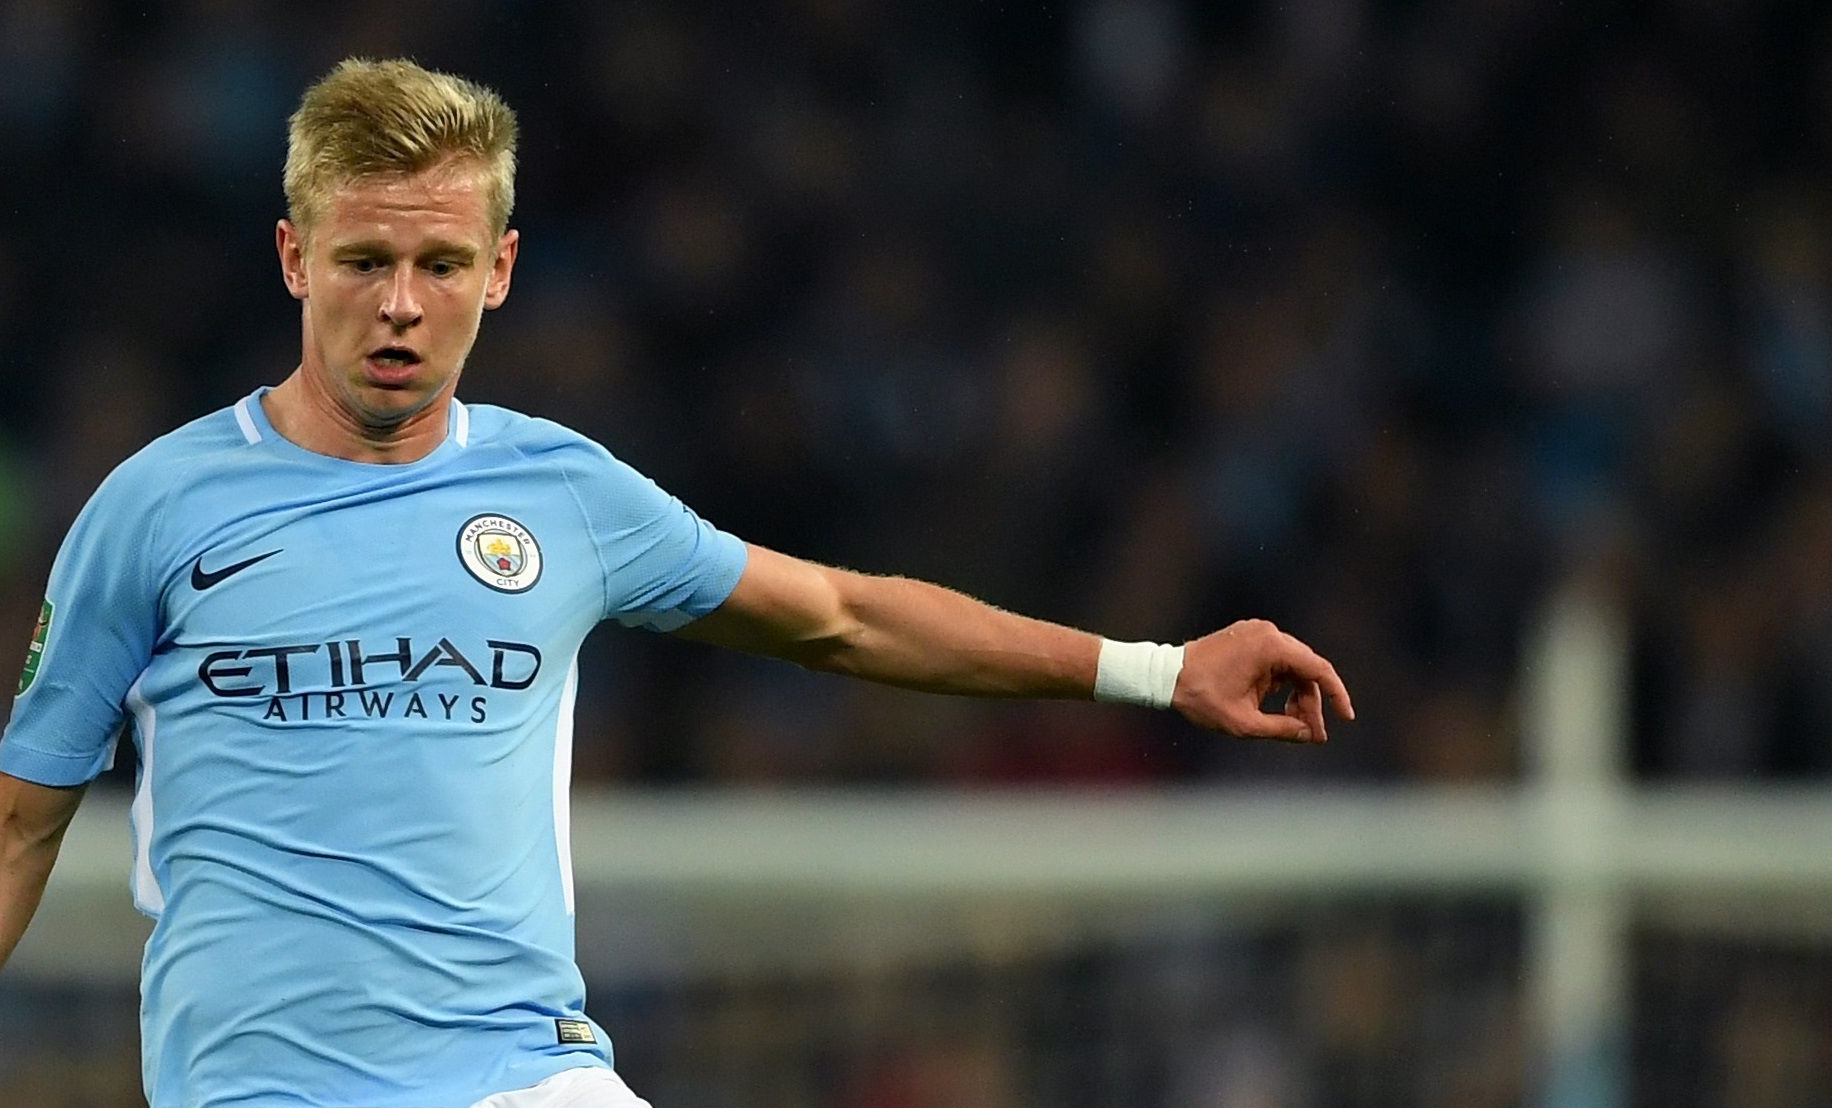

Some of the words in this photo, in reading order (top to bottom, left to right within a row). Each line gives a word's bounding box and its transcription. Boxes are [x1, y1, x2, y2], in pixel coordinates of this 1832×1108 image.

[465, 519, 531, 545] MANCHESTER
[496, 578, 520, 587] CITY
[197, 637, 543, 698] ETIHAD
[263, 690, 488, 724] AIRWAYS
